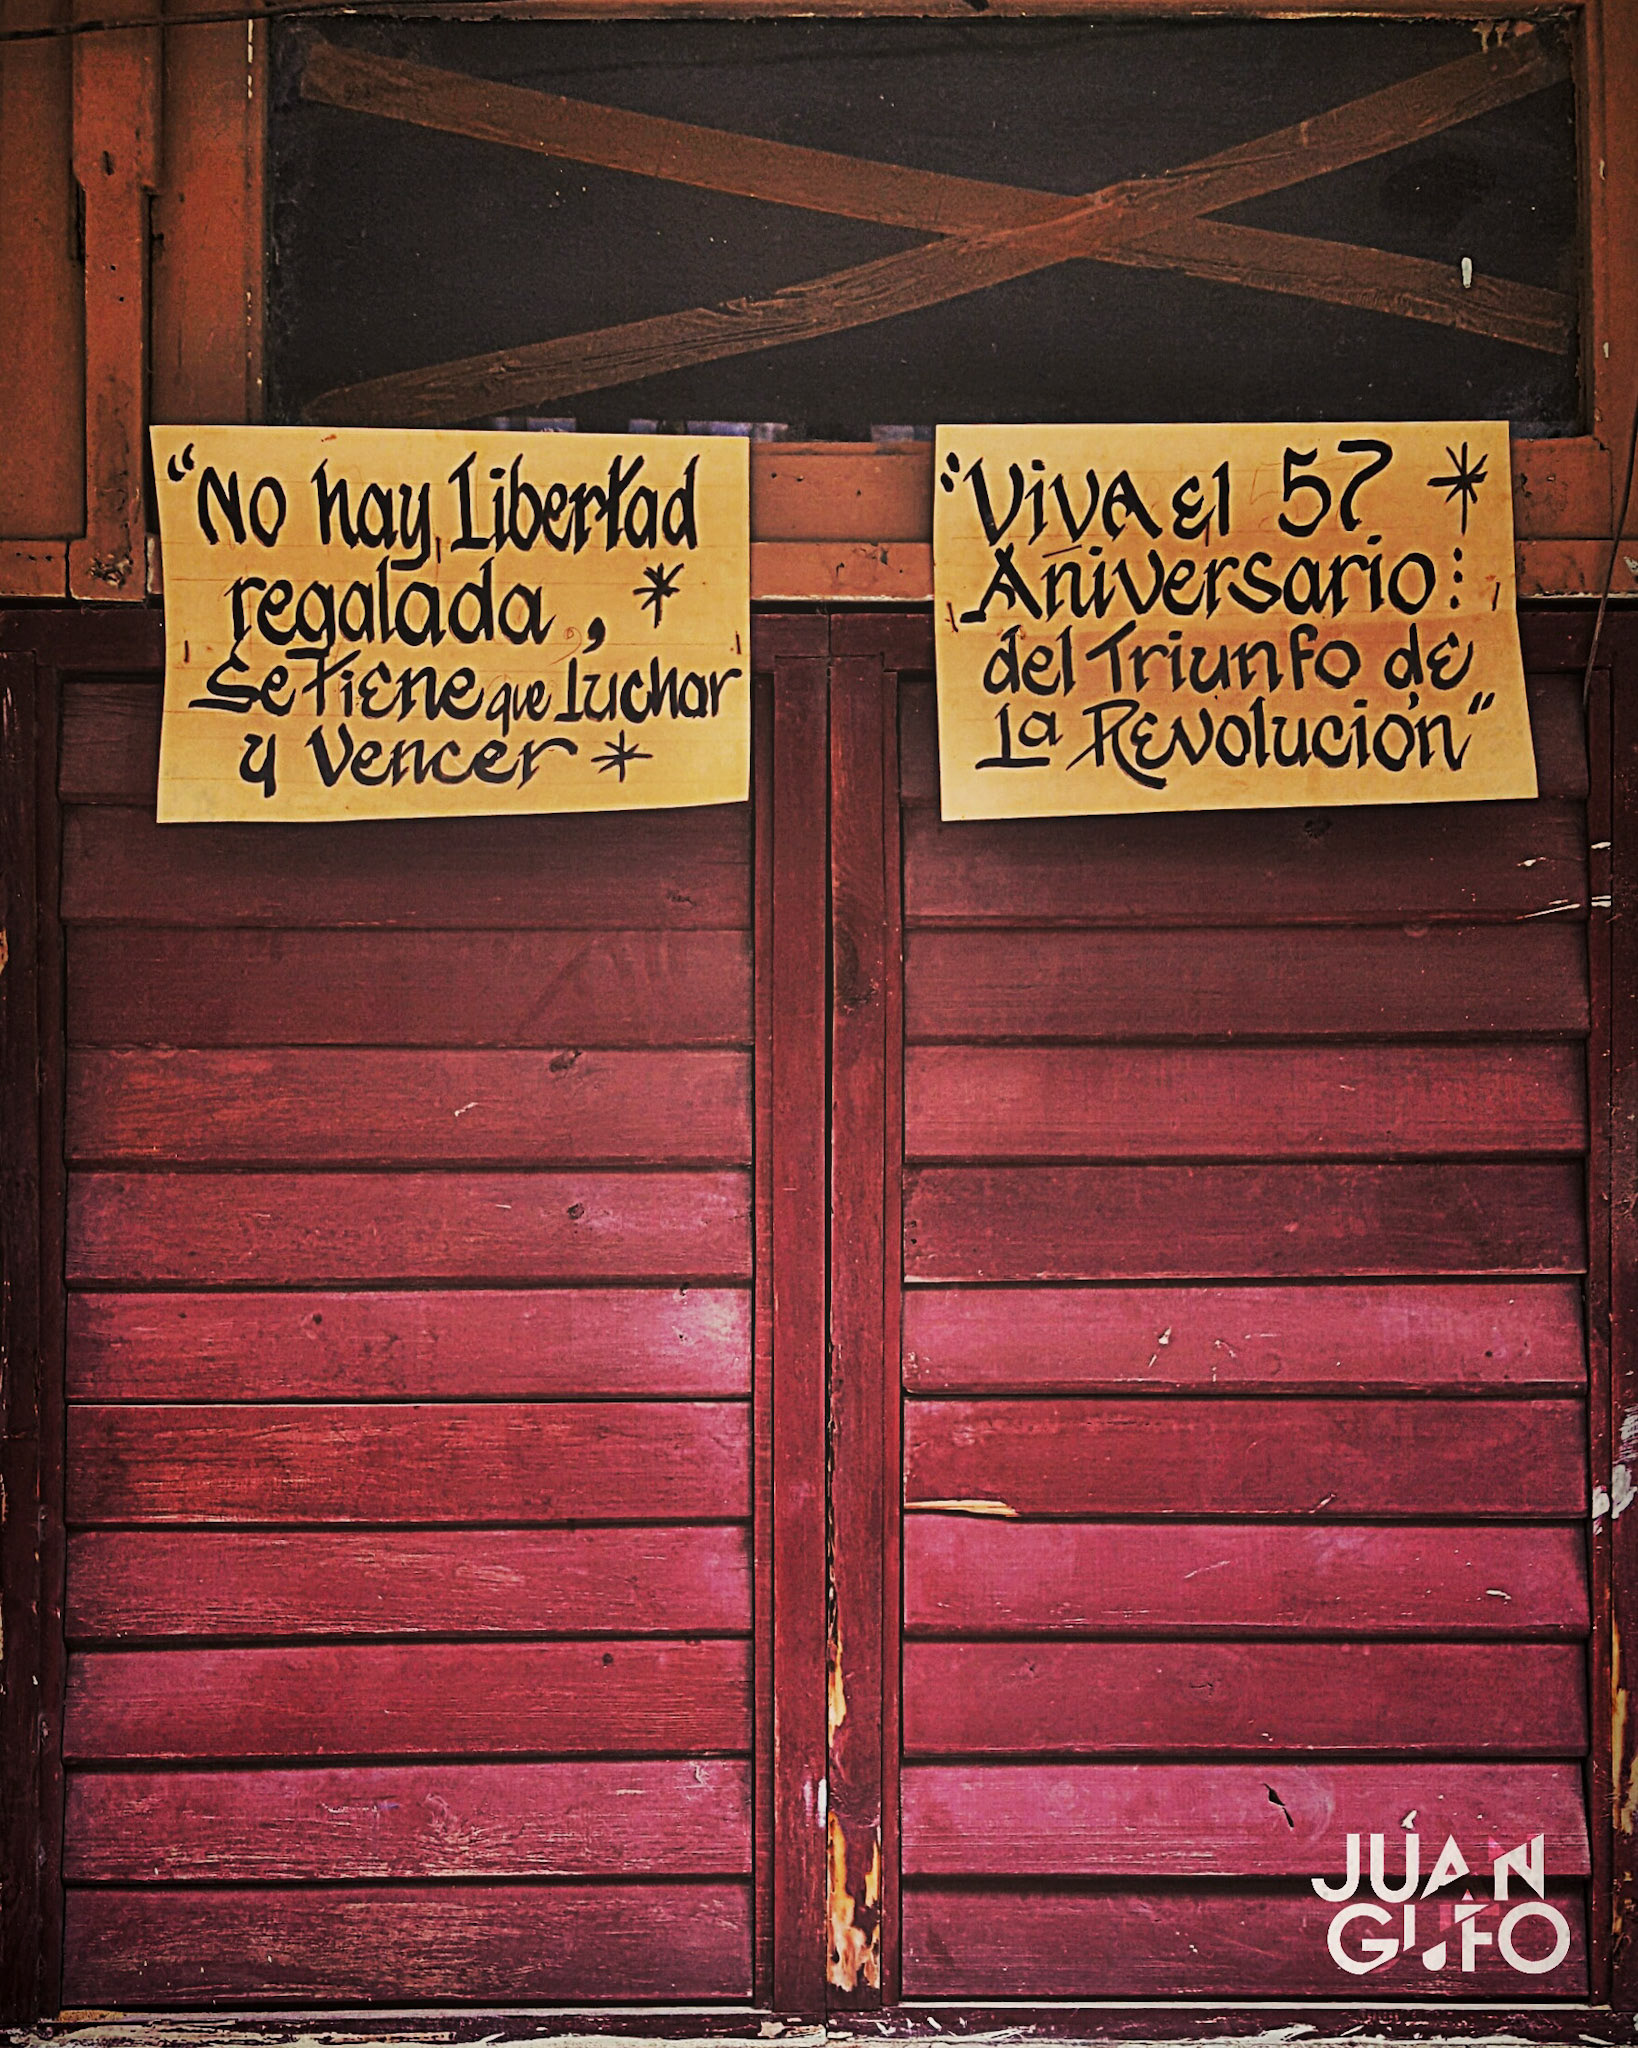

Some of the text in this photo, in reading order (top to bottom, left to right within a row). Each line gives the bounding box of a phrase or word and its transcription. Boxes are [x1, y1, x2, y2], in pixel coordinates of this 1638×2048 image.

[311, 458, 431, 571] hay
[448, 450, 700, 555] Libertad
[1277, 438, 1393, 538] 57
[188, 652, 297, 716] Se
[486, 680, 552, 738] que
[983, 624, 1074, 698] del
[1086, 619, 1361, 695] Triunfo
[239, 733, 277, 798] y
[975, 702, 1064, 770] La
